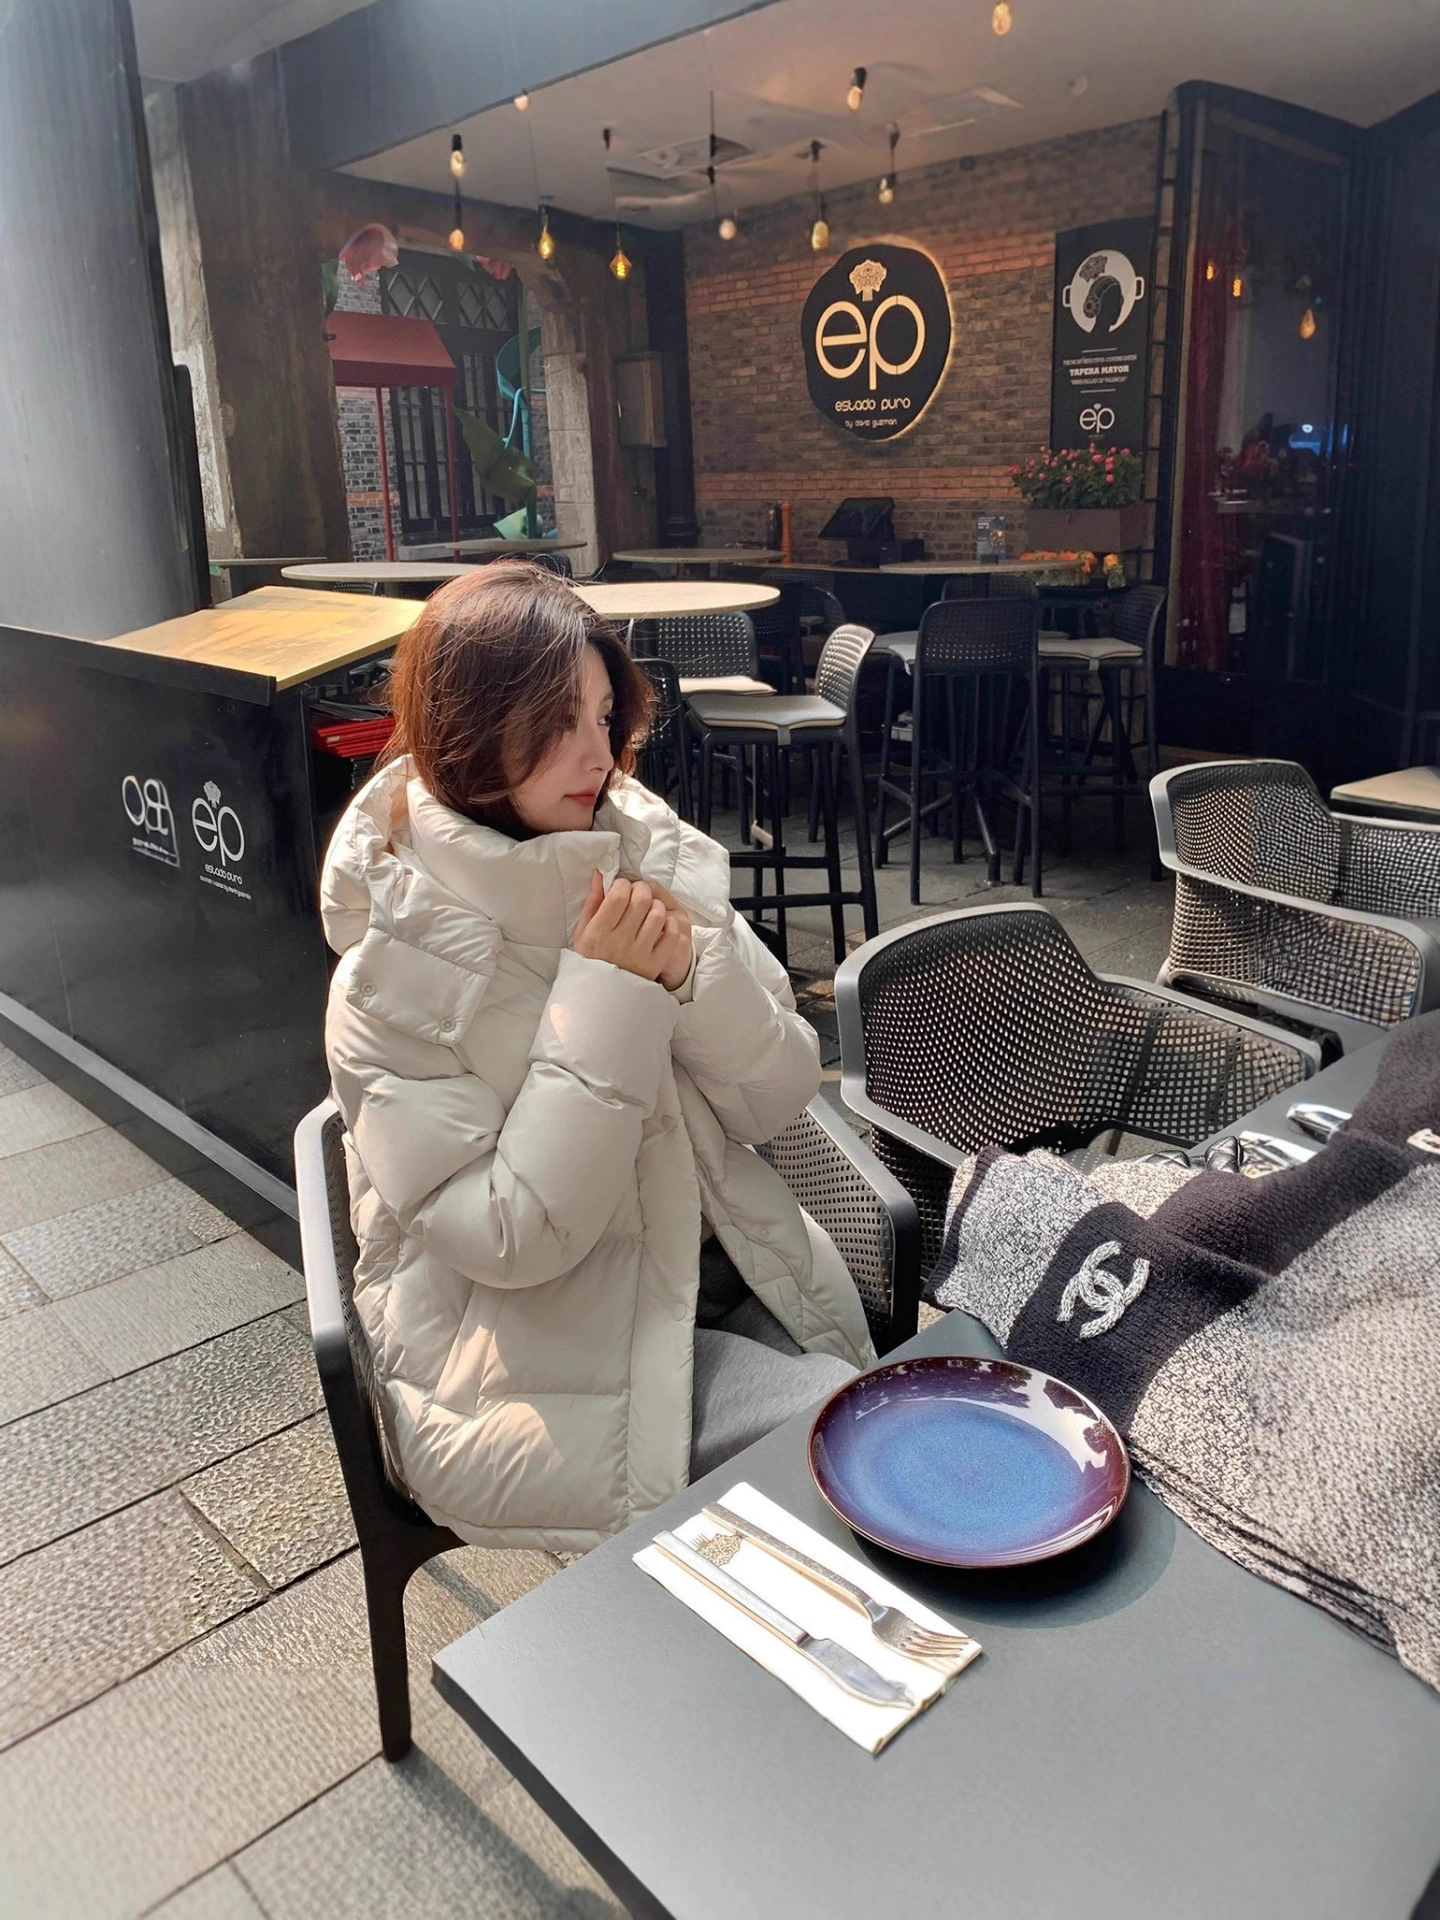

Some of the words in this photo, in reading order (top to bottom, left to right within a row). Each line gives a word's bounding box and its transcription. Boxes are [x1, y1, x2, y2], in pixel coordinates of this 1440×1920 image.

[816, 295, 925, 390] ep
[835, 398, 876, 412] estado
[881, 397, 911, 412] puro
[1079, 407, 1115, 433] ep
[192, 798, 245, 866] ep
